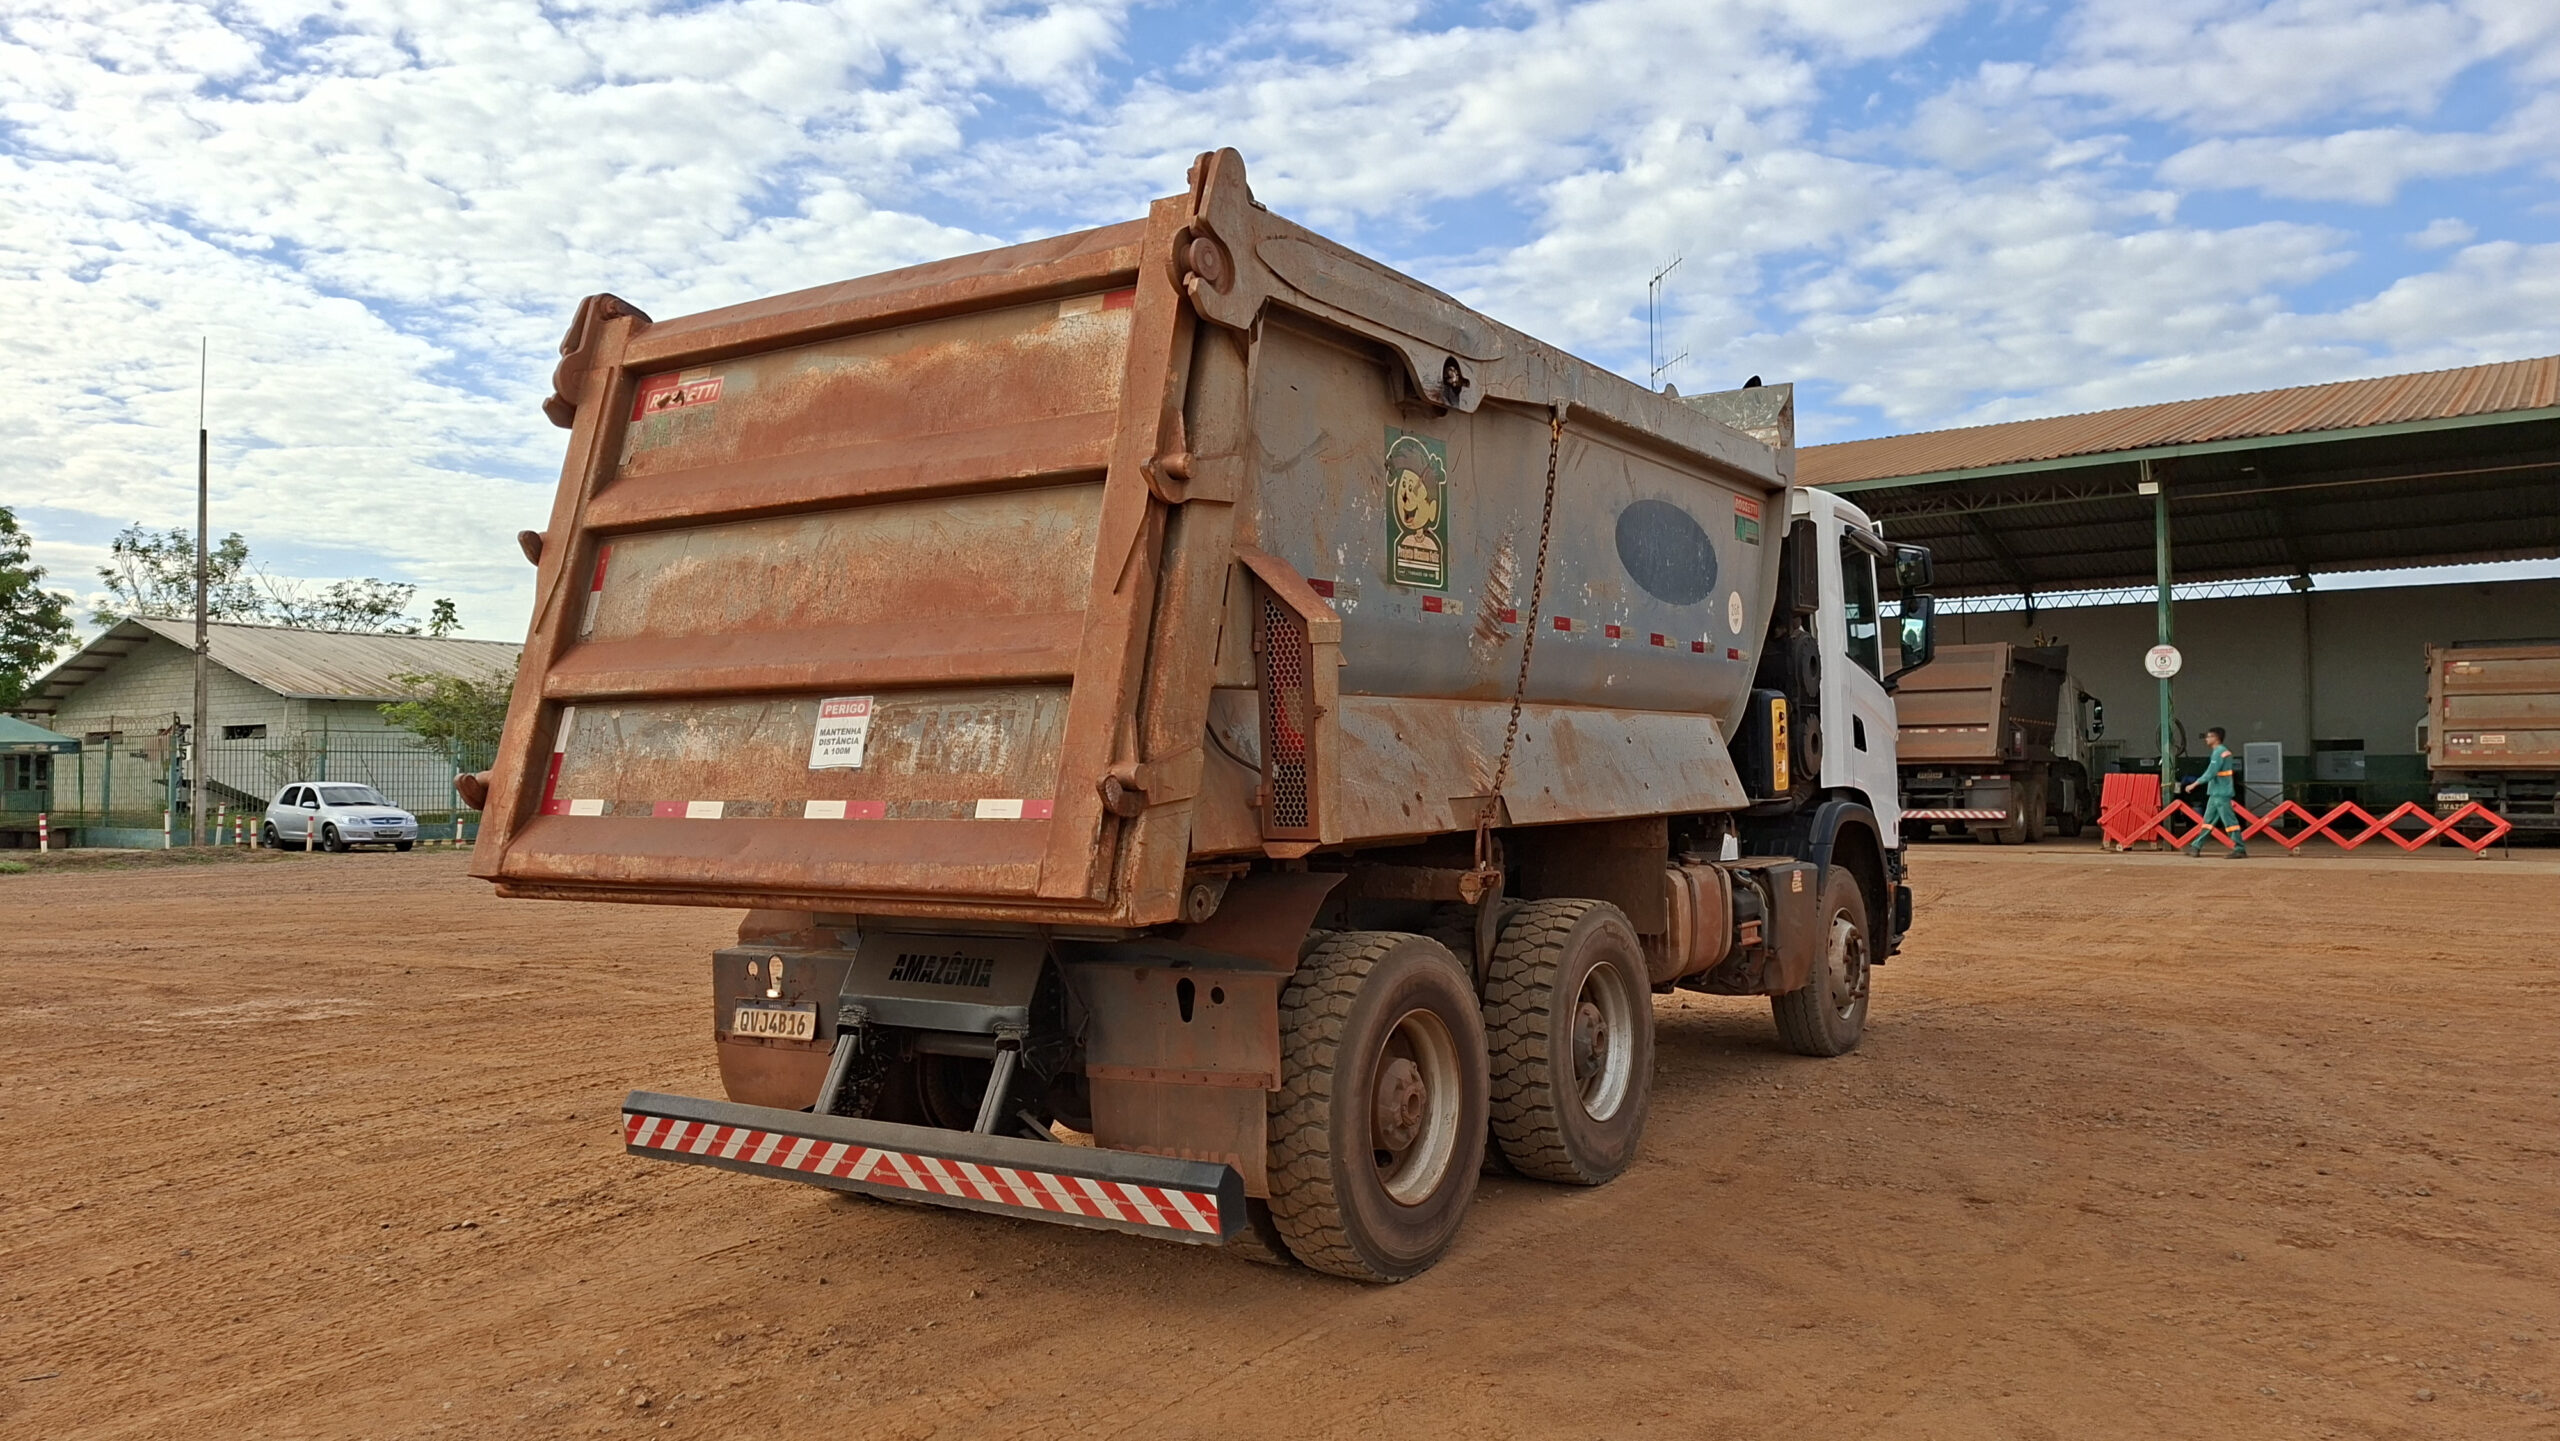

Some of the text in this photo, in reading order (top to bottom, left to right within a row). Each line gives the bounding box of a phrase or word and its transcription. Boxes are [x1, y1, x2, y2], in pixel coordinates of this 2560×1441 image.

[2160, 656, 2167, 664] 5
[824, 703, 866, 715] PERIGO
[820, 727, 861, 736] MANTENHA
[819, 737, 859, 746] DISTÂNCIA
[831, 747, 851, 755] 100M
[888, 951, 994, 988] AMAZÔNIA
[740, 1011, 806, 1036] QVJ4B16
